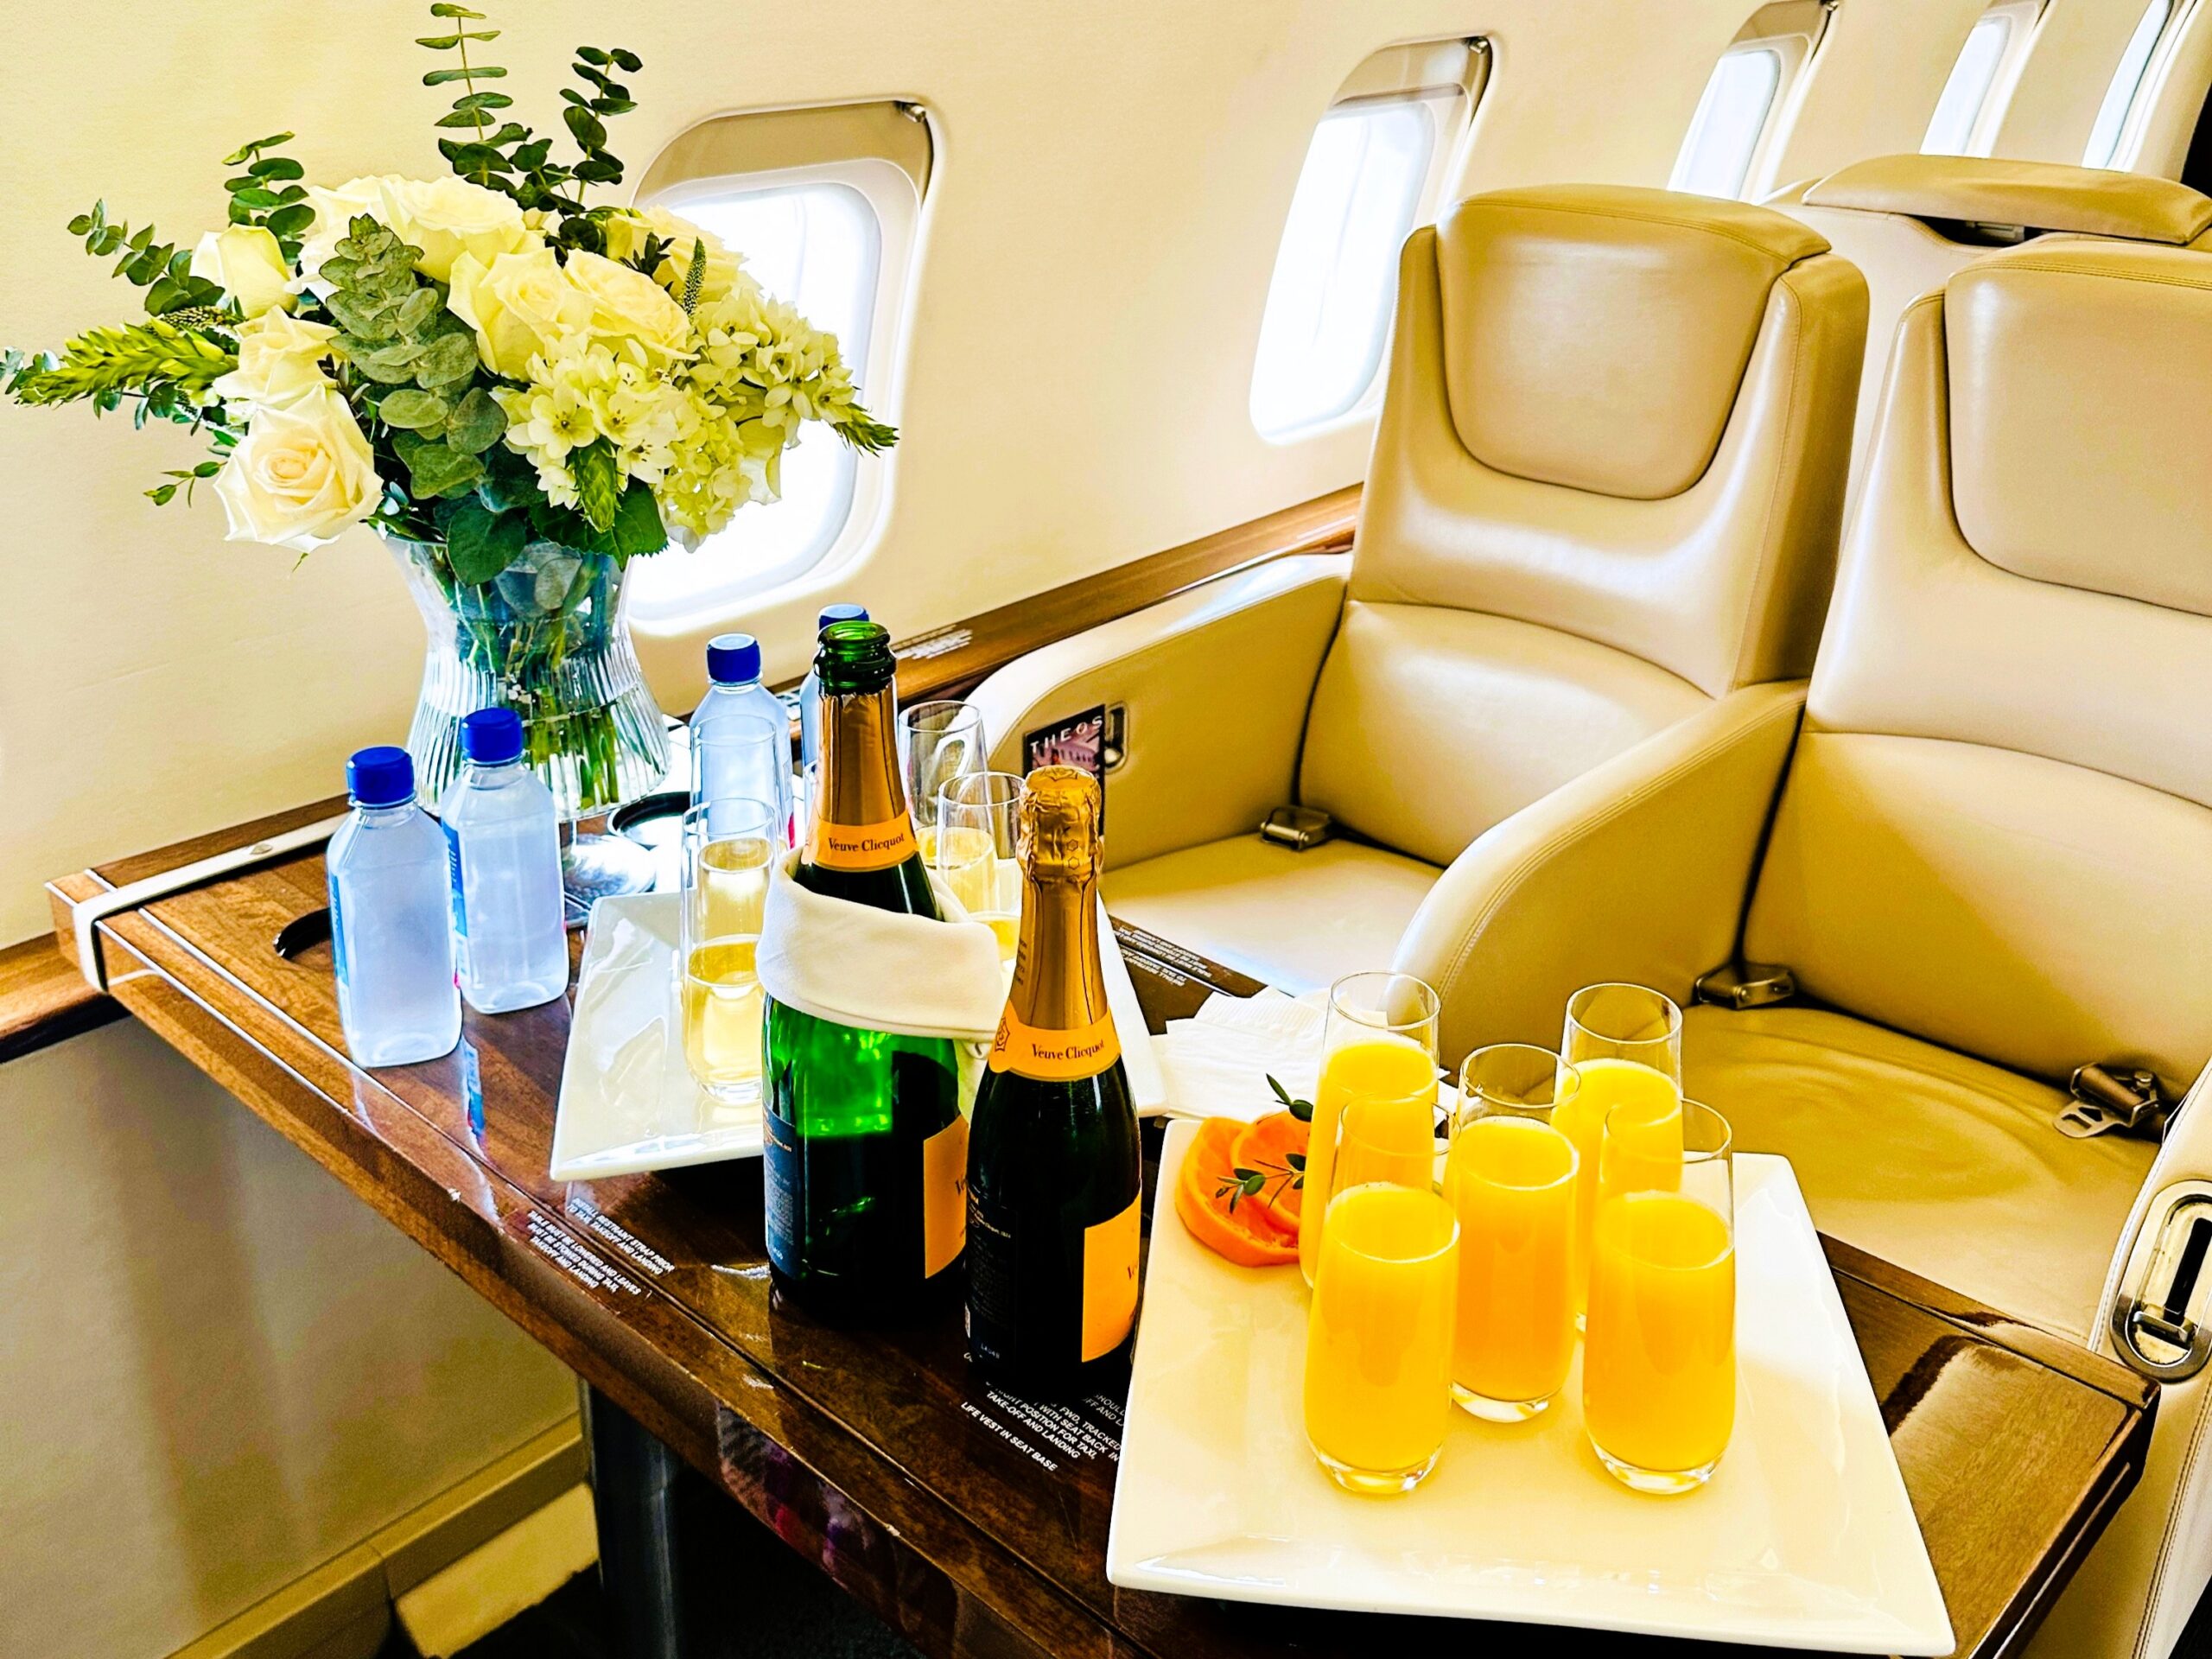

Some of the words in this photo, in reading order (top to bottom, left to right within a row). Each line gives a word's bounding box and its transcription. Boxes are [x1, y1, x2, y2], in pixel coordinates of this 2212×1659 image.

[1030, 715, 1103, 753] THEOS
[828, 837, 859, 852] Veuve
[861, 832, 906, 852] Clicquot
[1031, 1043, 1064, 1060] Veuve
[1065, 1039, 1105, 1060] Clicquot
[617, 1242, 635, 1255] AND
[631, 1251, 664, 1275] LANDING
[630, 1239, 655, 1256] STRAP
[555, 1255, 573, 1268] AND
[569, 1265, 600, 1290] LANDING
[599, 1264, 618, 1277] AND
[987, 1390, 1027, 1420] TAKE-OFF
[1022, 1418, 1044, 1433] AND
[1041, 1430, 1081, 1459] LANDING
[1020, 1402, 1060, 1432] POSITION
[1057, 1428, 1078, 1445] FOR
[1096, 1406, 1117, 1421] AND
[961, 1402, 979, 1416] LIFE
[979, 1414, 1003, 1432] VEST
[1000, 1429, 1013, 1440] IN
[1009, 1436, 1038, 1454] SEAT
[1031, 1452, 1058, 1471] BASE
[1039, 1404, 1062, 1422] WITH
[1059, 1419, 1085, 1436] SEAT
[1082, 1433, 1109, 1453] BACK
[1108, 1452, 1121, 1463] IN
[1082, 1421, 1122, 1451] TRACKED
